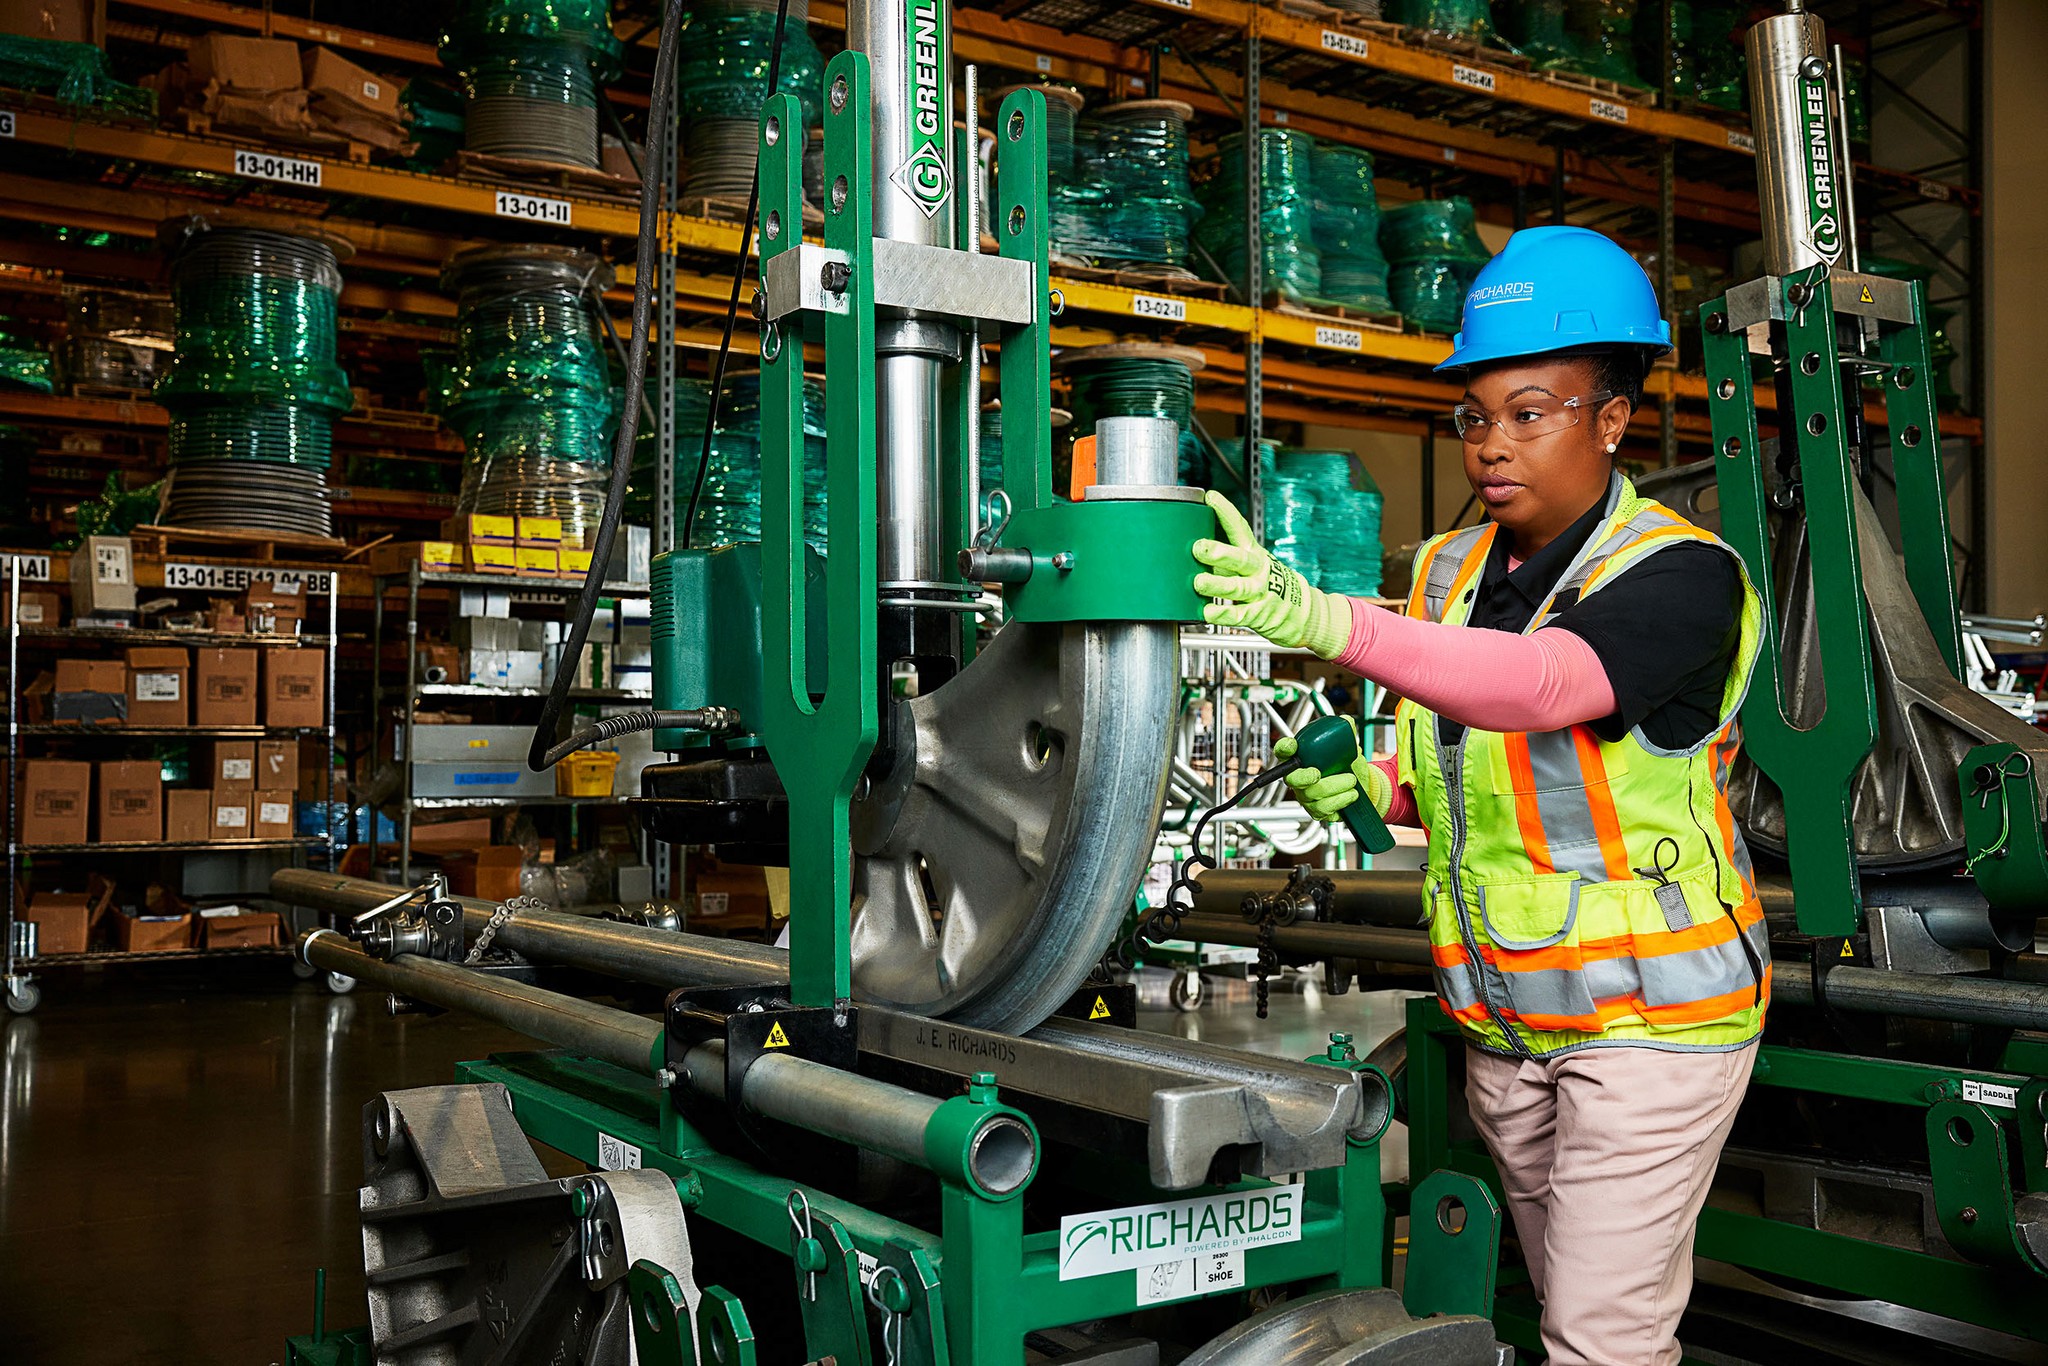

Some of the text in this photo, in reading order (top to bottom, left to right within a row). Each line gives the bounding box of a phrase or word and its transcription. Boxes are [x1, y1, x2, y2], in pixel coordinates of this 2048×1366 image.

[1806, 86, 1832, 209] GREENLEE
[237, 154, 318, 184] 13-01-HH
[498, 195, 568, 222] 13-01-II
[1474, 282, 1535, 301] RICHARDS
[1136, 299, 1183, 318] 13-02-II
[916, 1026, 1017, 1064] J. E. RICHARDS
[1982, 1089, 2014, 1101] SADDLE
[1109, 1192, 1293, 1255] RICHARDS
[1184, 1230, 1292, 1254] POWERED BY PHALCON
[1207, 1269, 1234, 1283] SHOE
